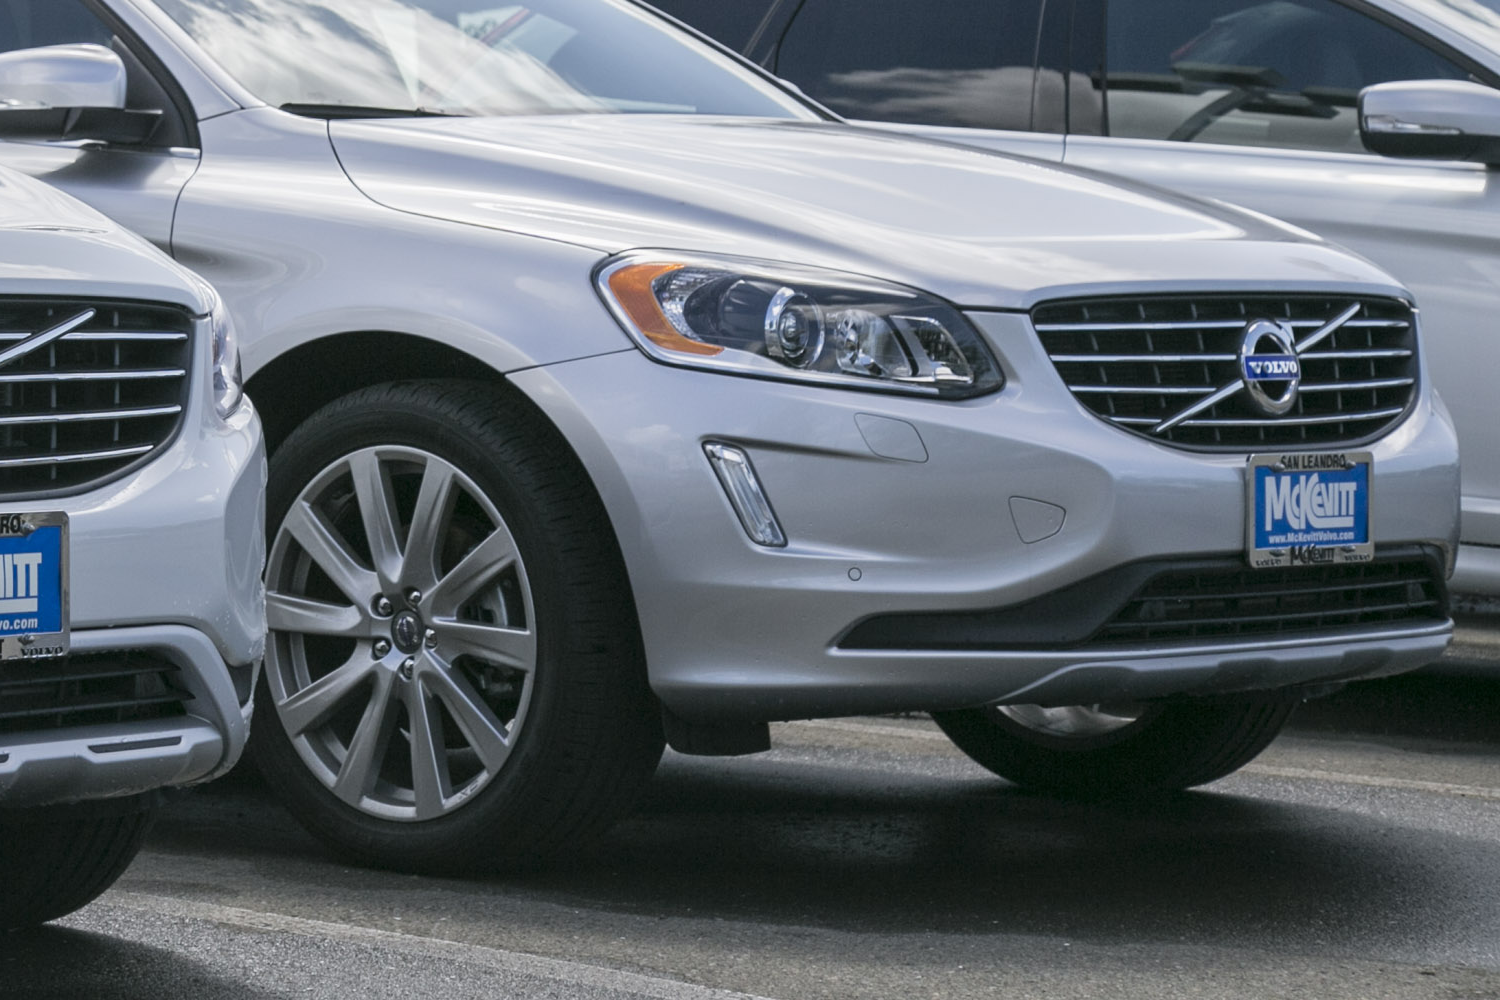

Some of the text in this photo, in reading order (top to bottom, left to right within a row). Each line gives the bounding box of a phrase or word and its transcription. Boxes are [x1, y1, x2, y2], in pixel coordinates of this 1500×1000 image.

[1248, 360, 1298, 375] VOLVO
[1280, 454, 1346, 469] SAN LEANDRO
[20, 646, 63, 657] VOLVO
